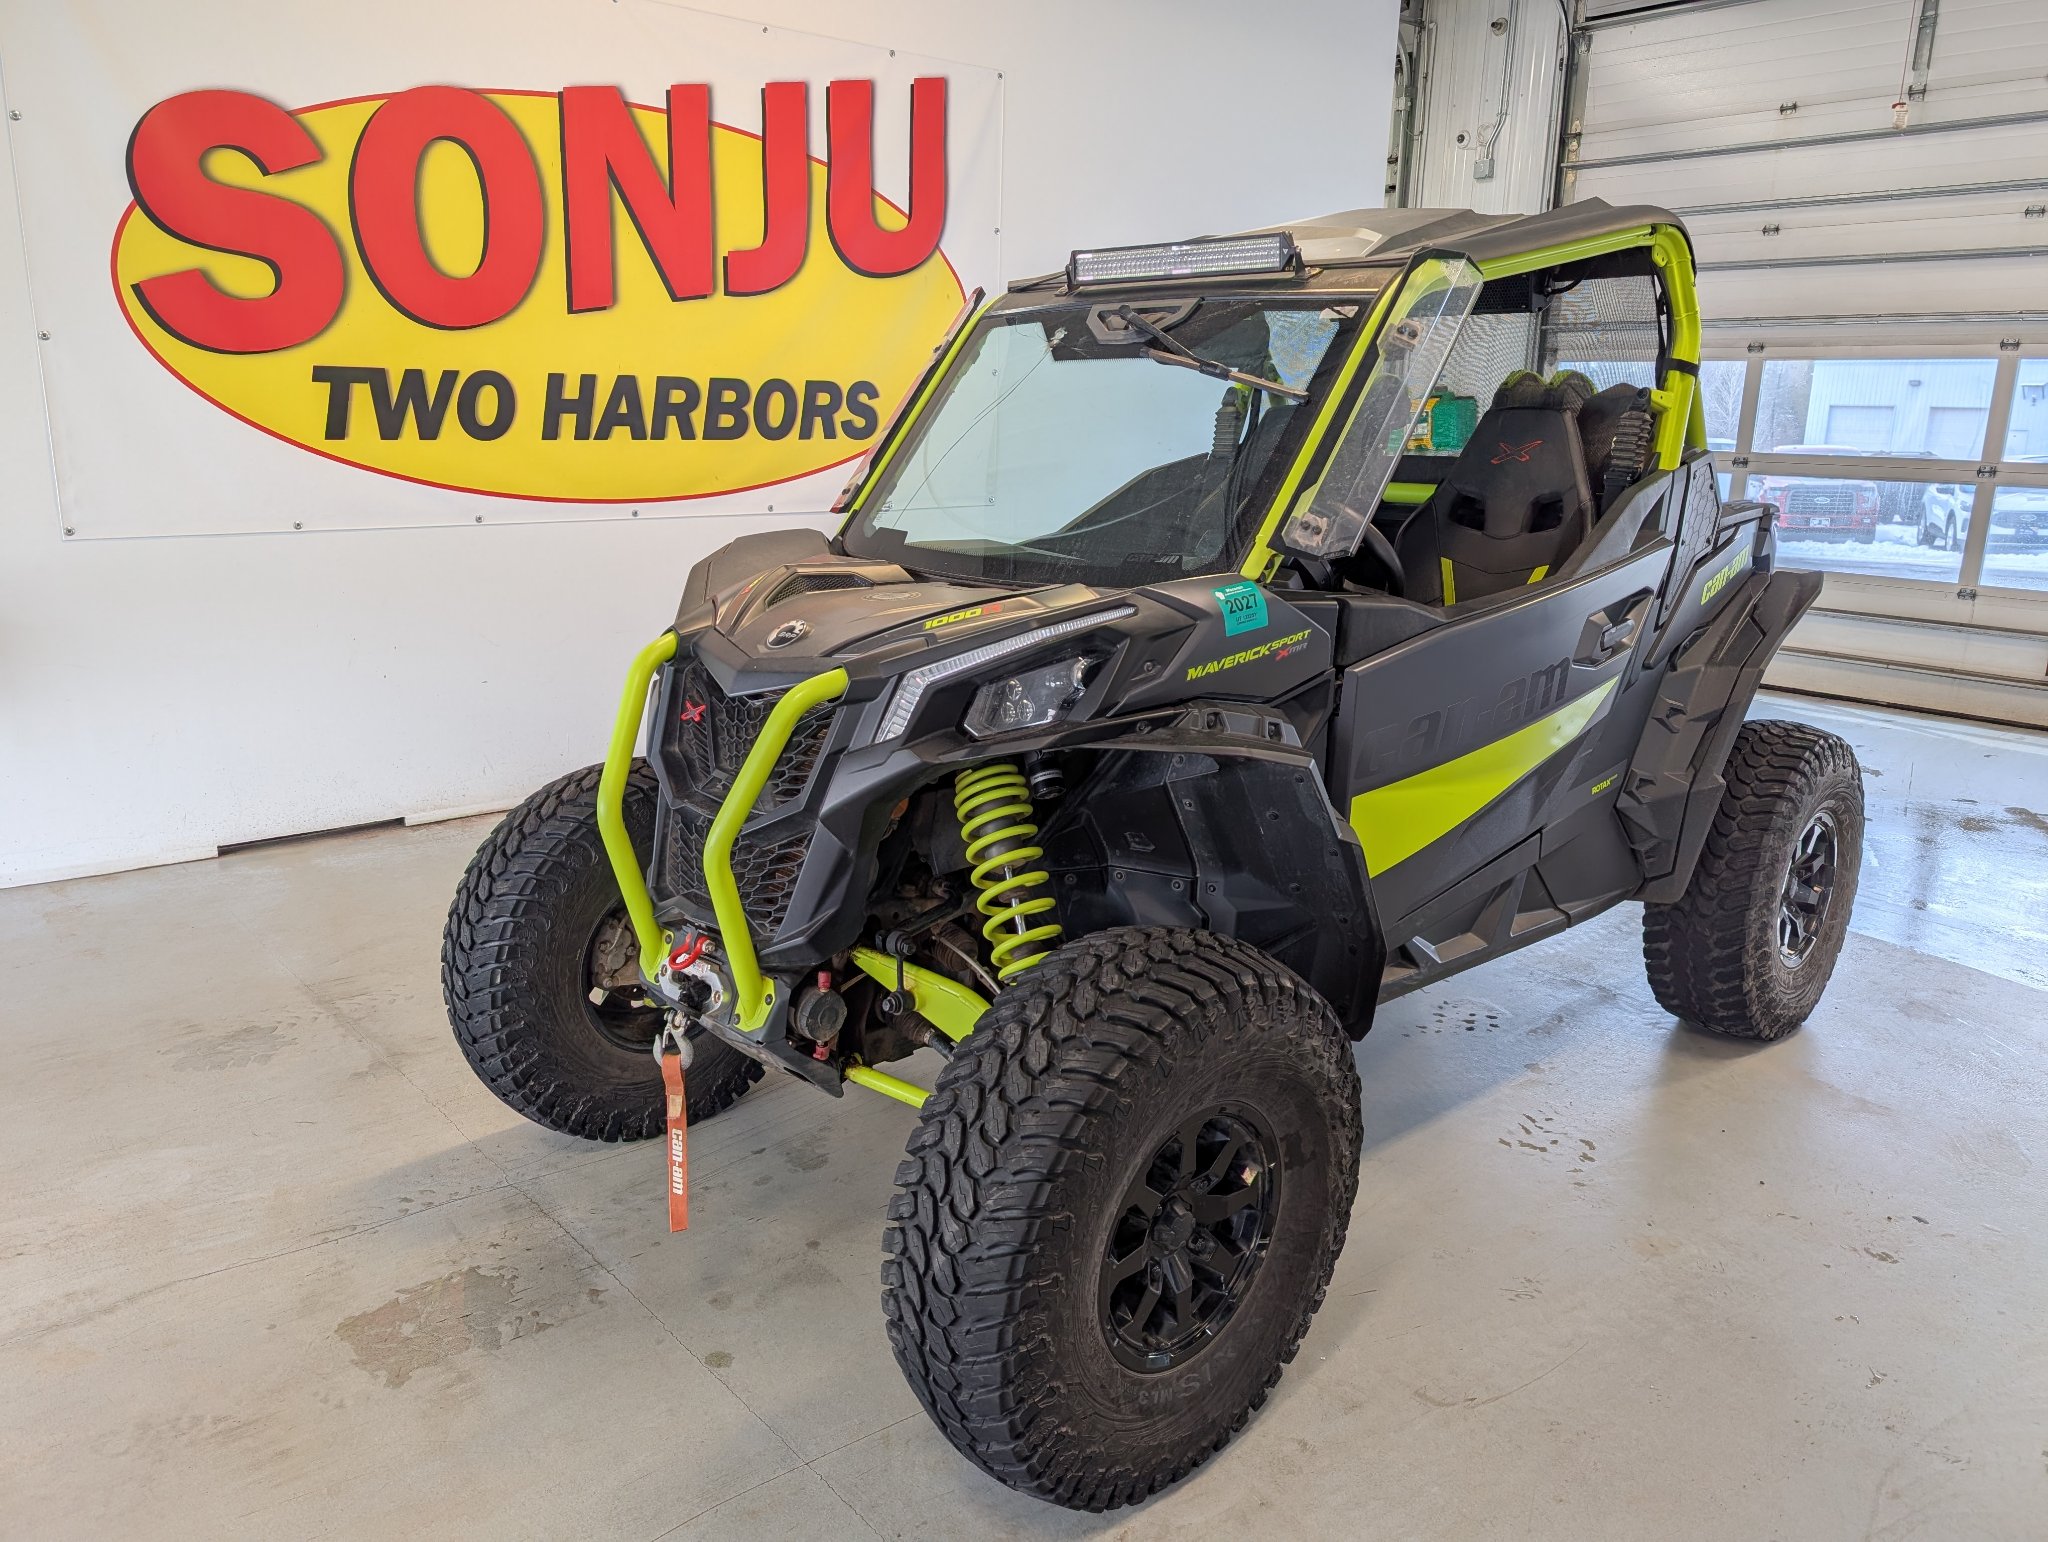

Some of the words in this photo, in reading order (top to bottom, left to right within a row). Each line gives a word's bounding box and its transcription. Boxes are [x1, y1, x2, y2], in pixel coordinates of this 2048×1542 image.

[126, 77, 946, 355] SONJU
[311, 365, 516, 442] TWO
[541, 372, 880, 441] HARBORS
[923, 602, 1003, 630] 1000R
[1224, 593, 1258, 615] 2027
[778, 631, 797, 639] BRP
[1186, 643, 1271, 681] MAVERICK
[1270, 629, 1312, 651] SPORT
[1591, 779, 1611, 795] ROTAX
[671, 1128, 684, 1196] can-am
